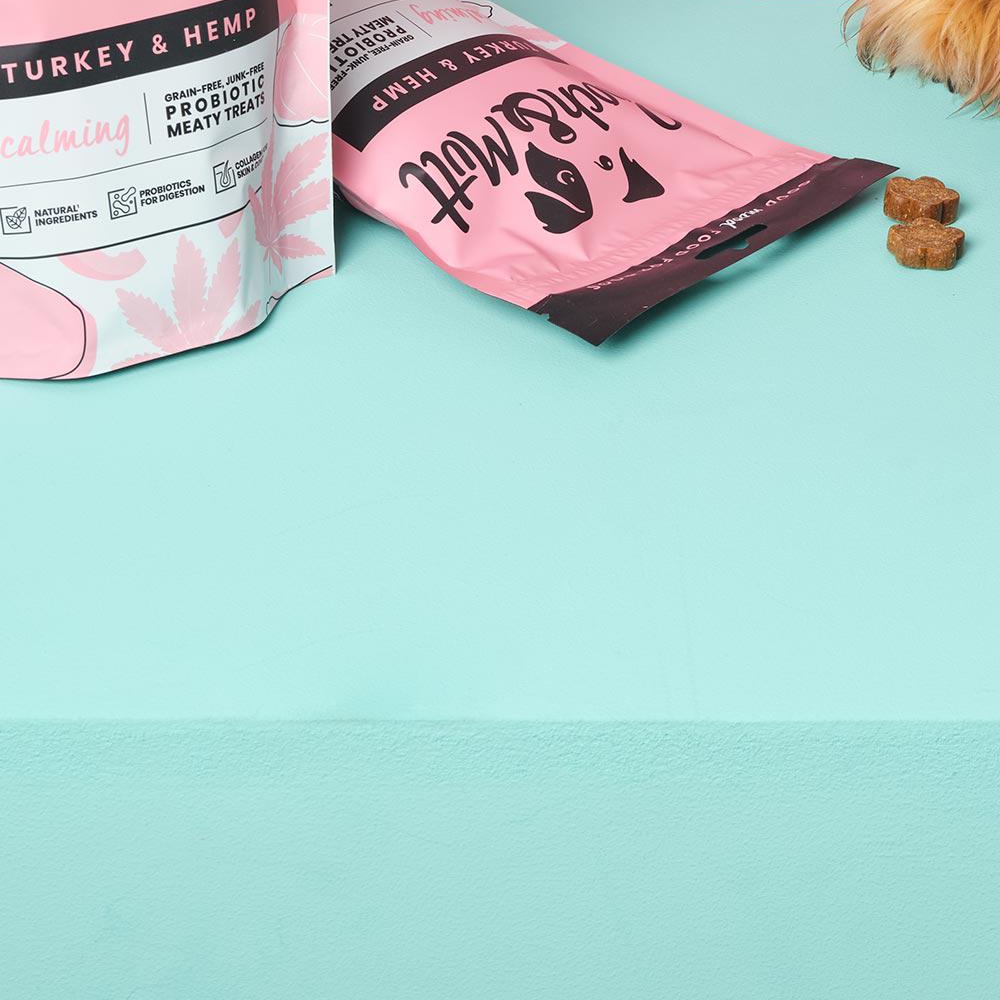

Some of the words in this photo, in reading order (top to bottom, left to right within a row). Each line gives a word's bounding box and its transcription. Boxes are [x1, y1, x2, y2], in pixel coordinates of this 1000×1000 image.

[1, 40, 134, 84] TURKEY
[152, 34, 168, 55] &
[184, 7, 258, 48] HEMP
[352, 15, 395, 38] MEATY
[437, 58, 458, 72] &
[462, 39, 540, 64] TURKEY
[164, 79, 225, 103] GRAIN-FREE,
[226, 61, 264, 86] JUNK-FREE
[165, 74, 264, 121] PROBIOTIC
[372, 67, 438, 112] HEMP
[166, 111, 221, 138] MEATY
[225, 91, 265, 122] TREATS
[1, 114, 130, 158] calming
[139, 178, 192, 198] PROBIOTICS
[140, 196, 158, 207] FOR
[158, 184, 206, 203] DIGESTION
[399, 116, 519, 234] Mutt
[35, 209, 98, 227] INGREDIENTS
